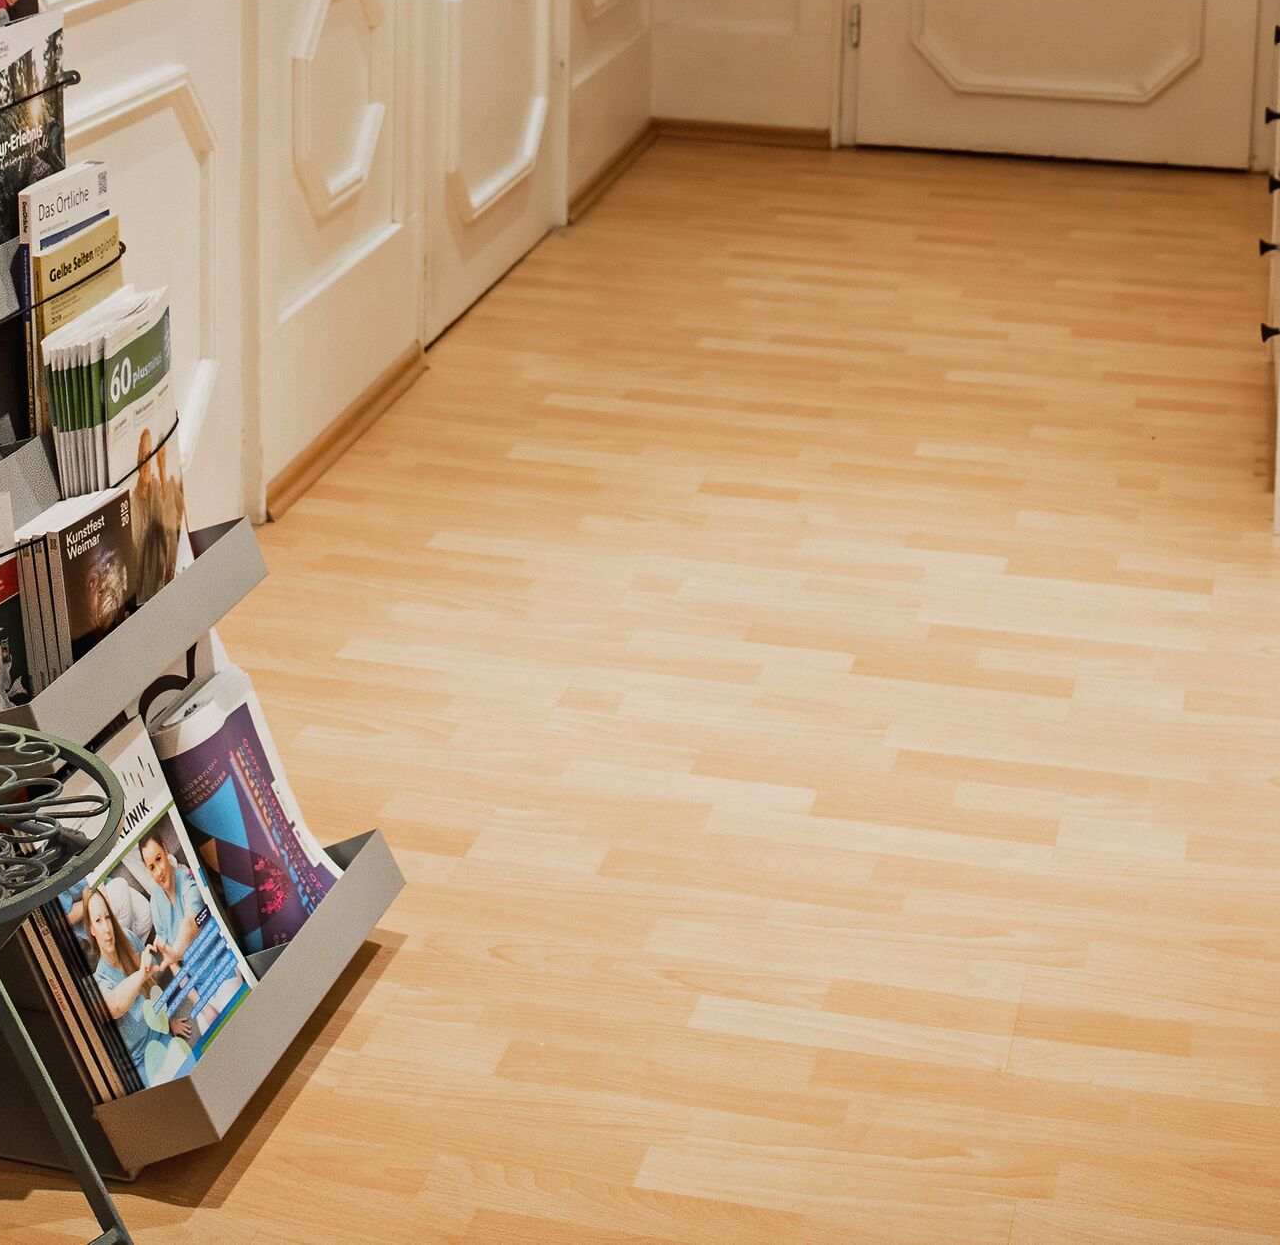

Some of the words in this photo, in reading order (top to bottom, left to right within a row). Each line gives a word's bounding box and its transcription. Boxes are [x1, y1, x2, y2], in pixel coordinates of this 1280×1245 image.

[38, 203, 55, 222] Das
[56, 187, 90, 214] Örtliche
[49, 261, 72, 283] Gelbe
[72, 250, 94, 271] Seiten
[110, 356, 132, 403] 60
[65, 515, 106, 547] Kunstfest
[67, 533, 101, 561] Weimar
